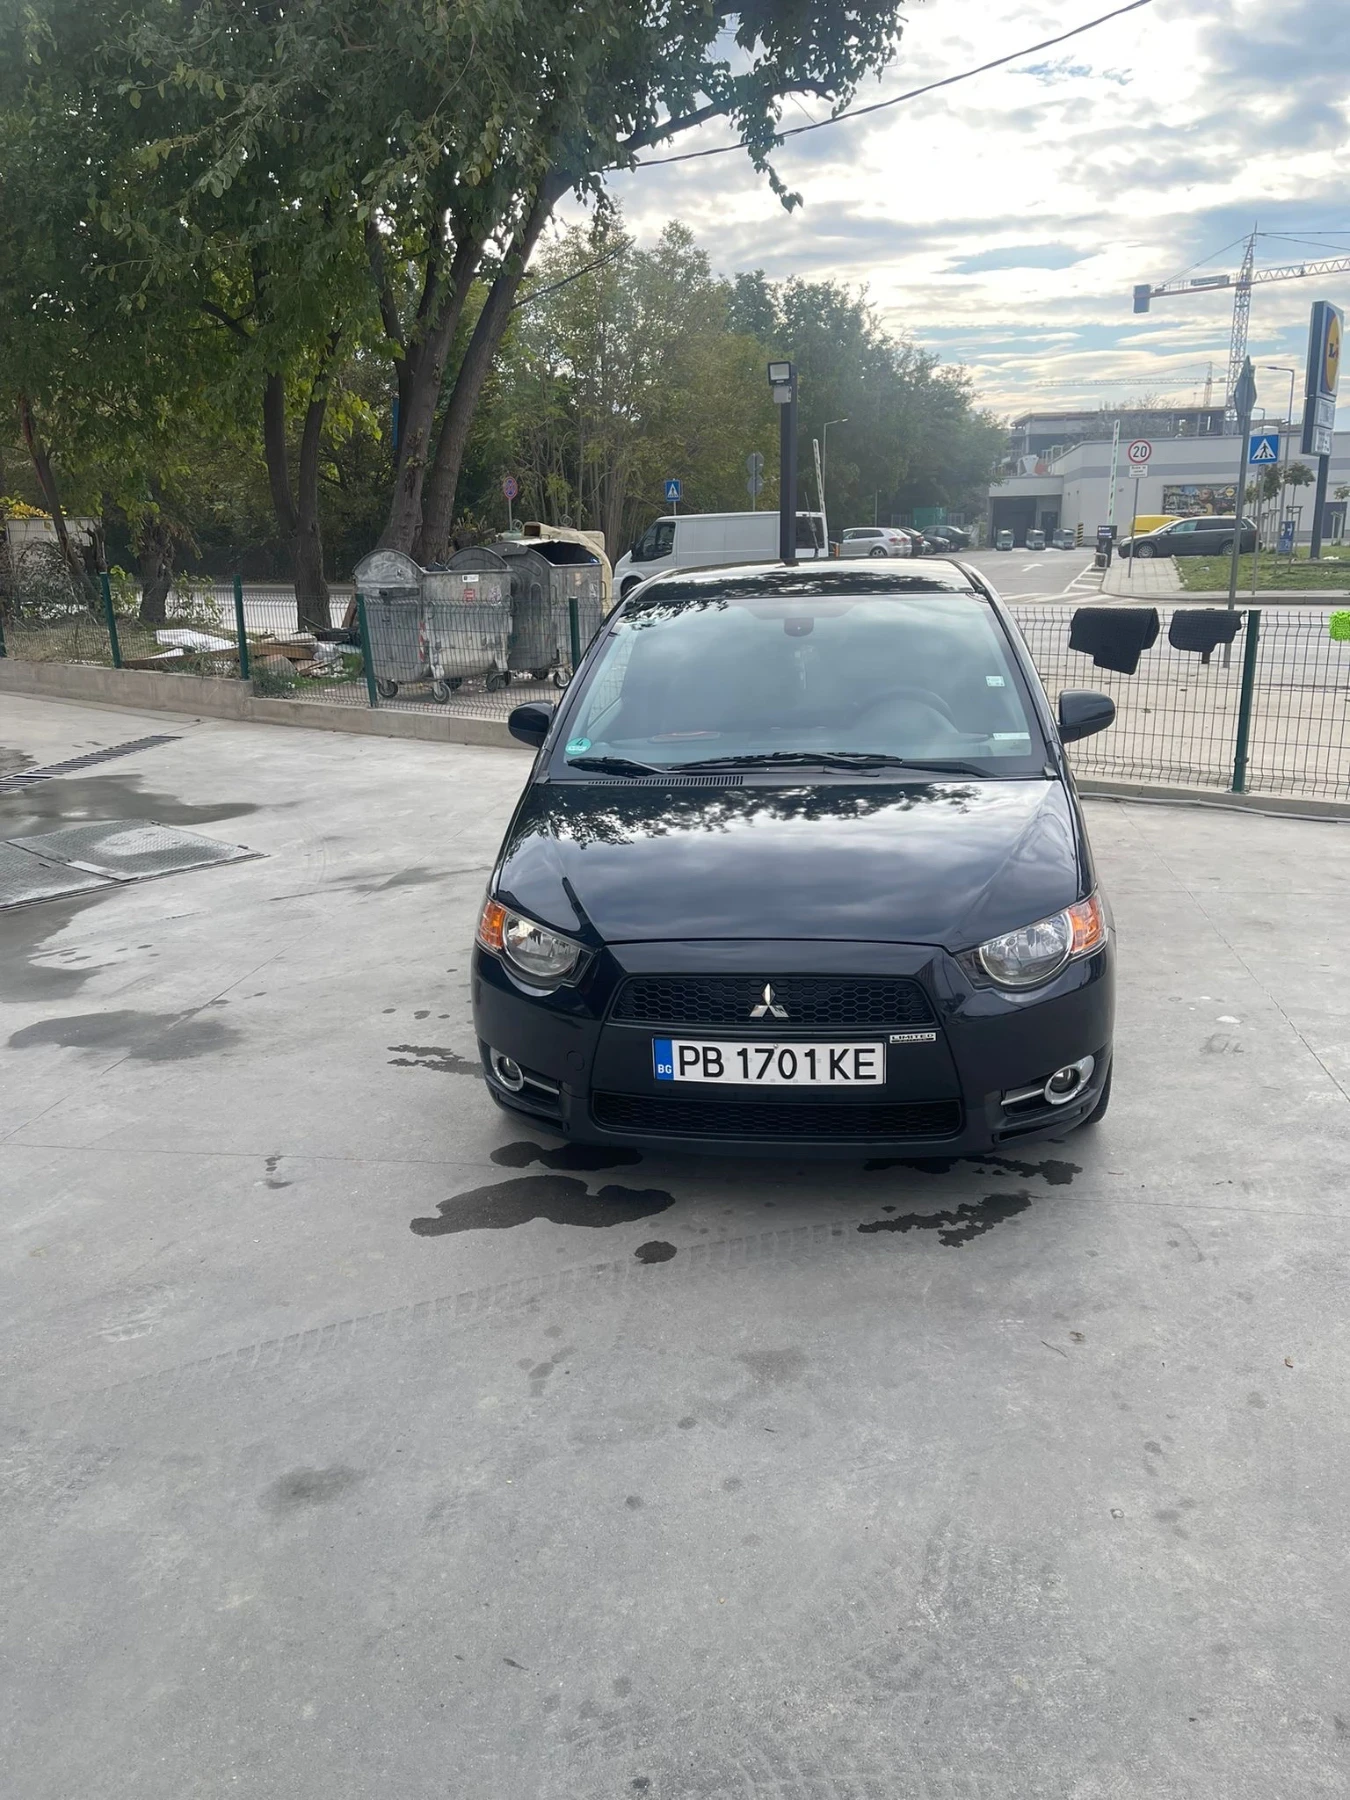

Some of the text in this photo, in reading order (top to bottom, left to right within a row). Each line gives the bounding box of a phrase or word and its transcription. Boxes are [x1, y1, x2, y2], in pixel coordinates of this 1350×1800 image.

[1133, 445, 1147, 458] 20
[657, 1064, 672, 1074] BG
[678, 1045, 877, 1080] PB 1701 KE
